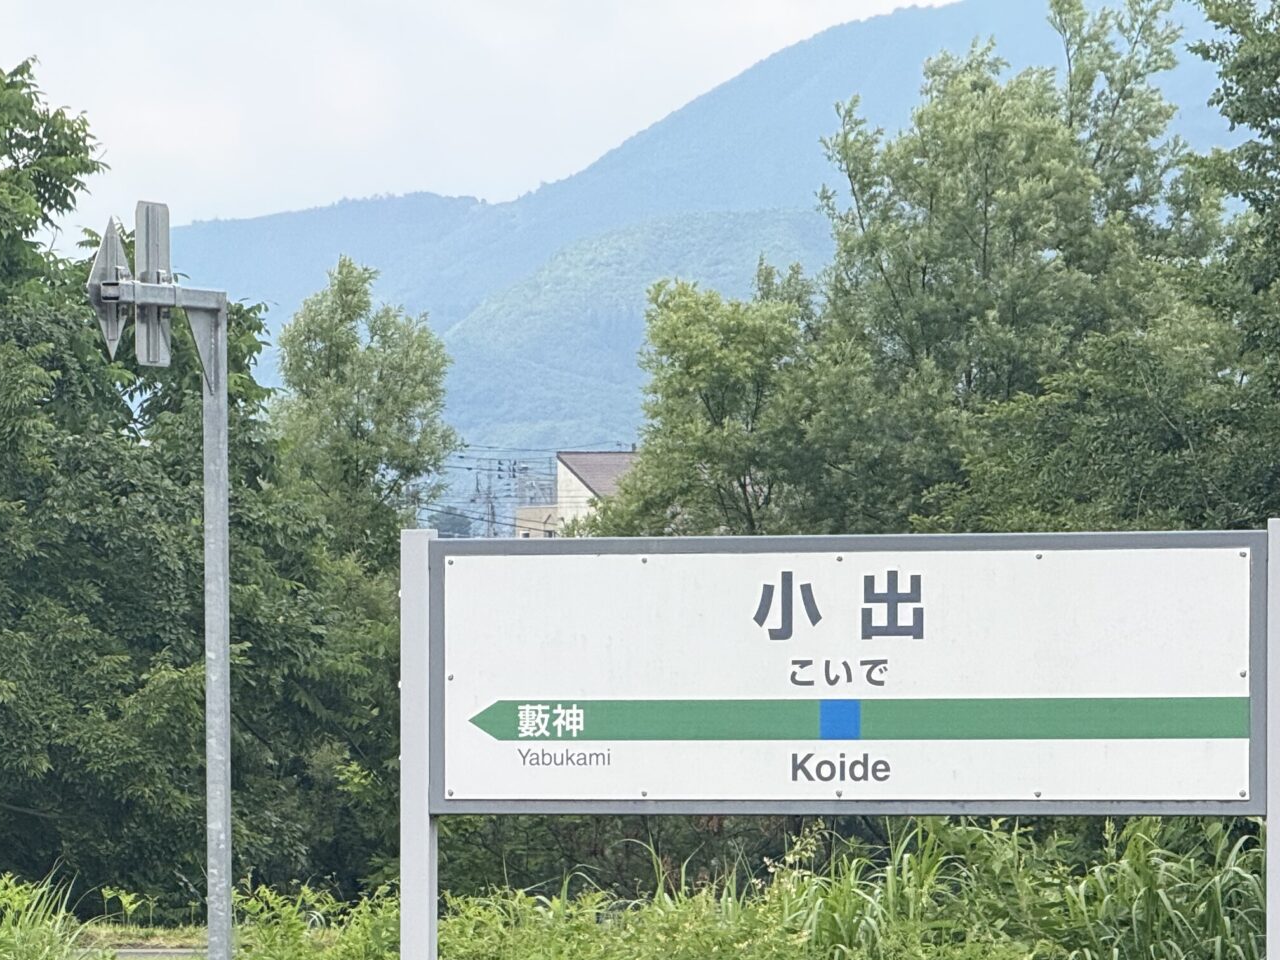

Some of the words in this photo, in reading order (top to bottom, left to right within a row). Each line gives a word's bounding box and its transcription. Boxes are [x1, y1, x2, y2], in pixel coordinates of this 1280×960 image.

[753, 570, 924, 641] 小出
[790, 659, 888, 686] こいで
[517, 704, 584, 737] 藪神
[517, 748, 611, 766] Yabukami
[791, 753, 891, 782] Koide
